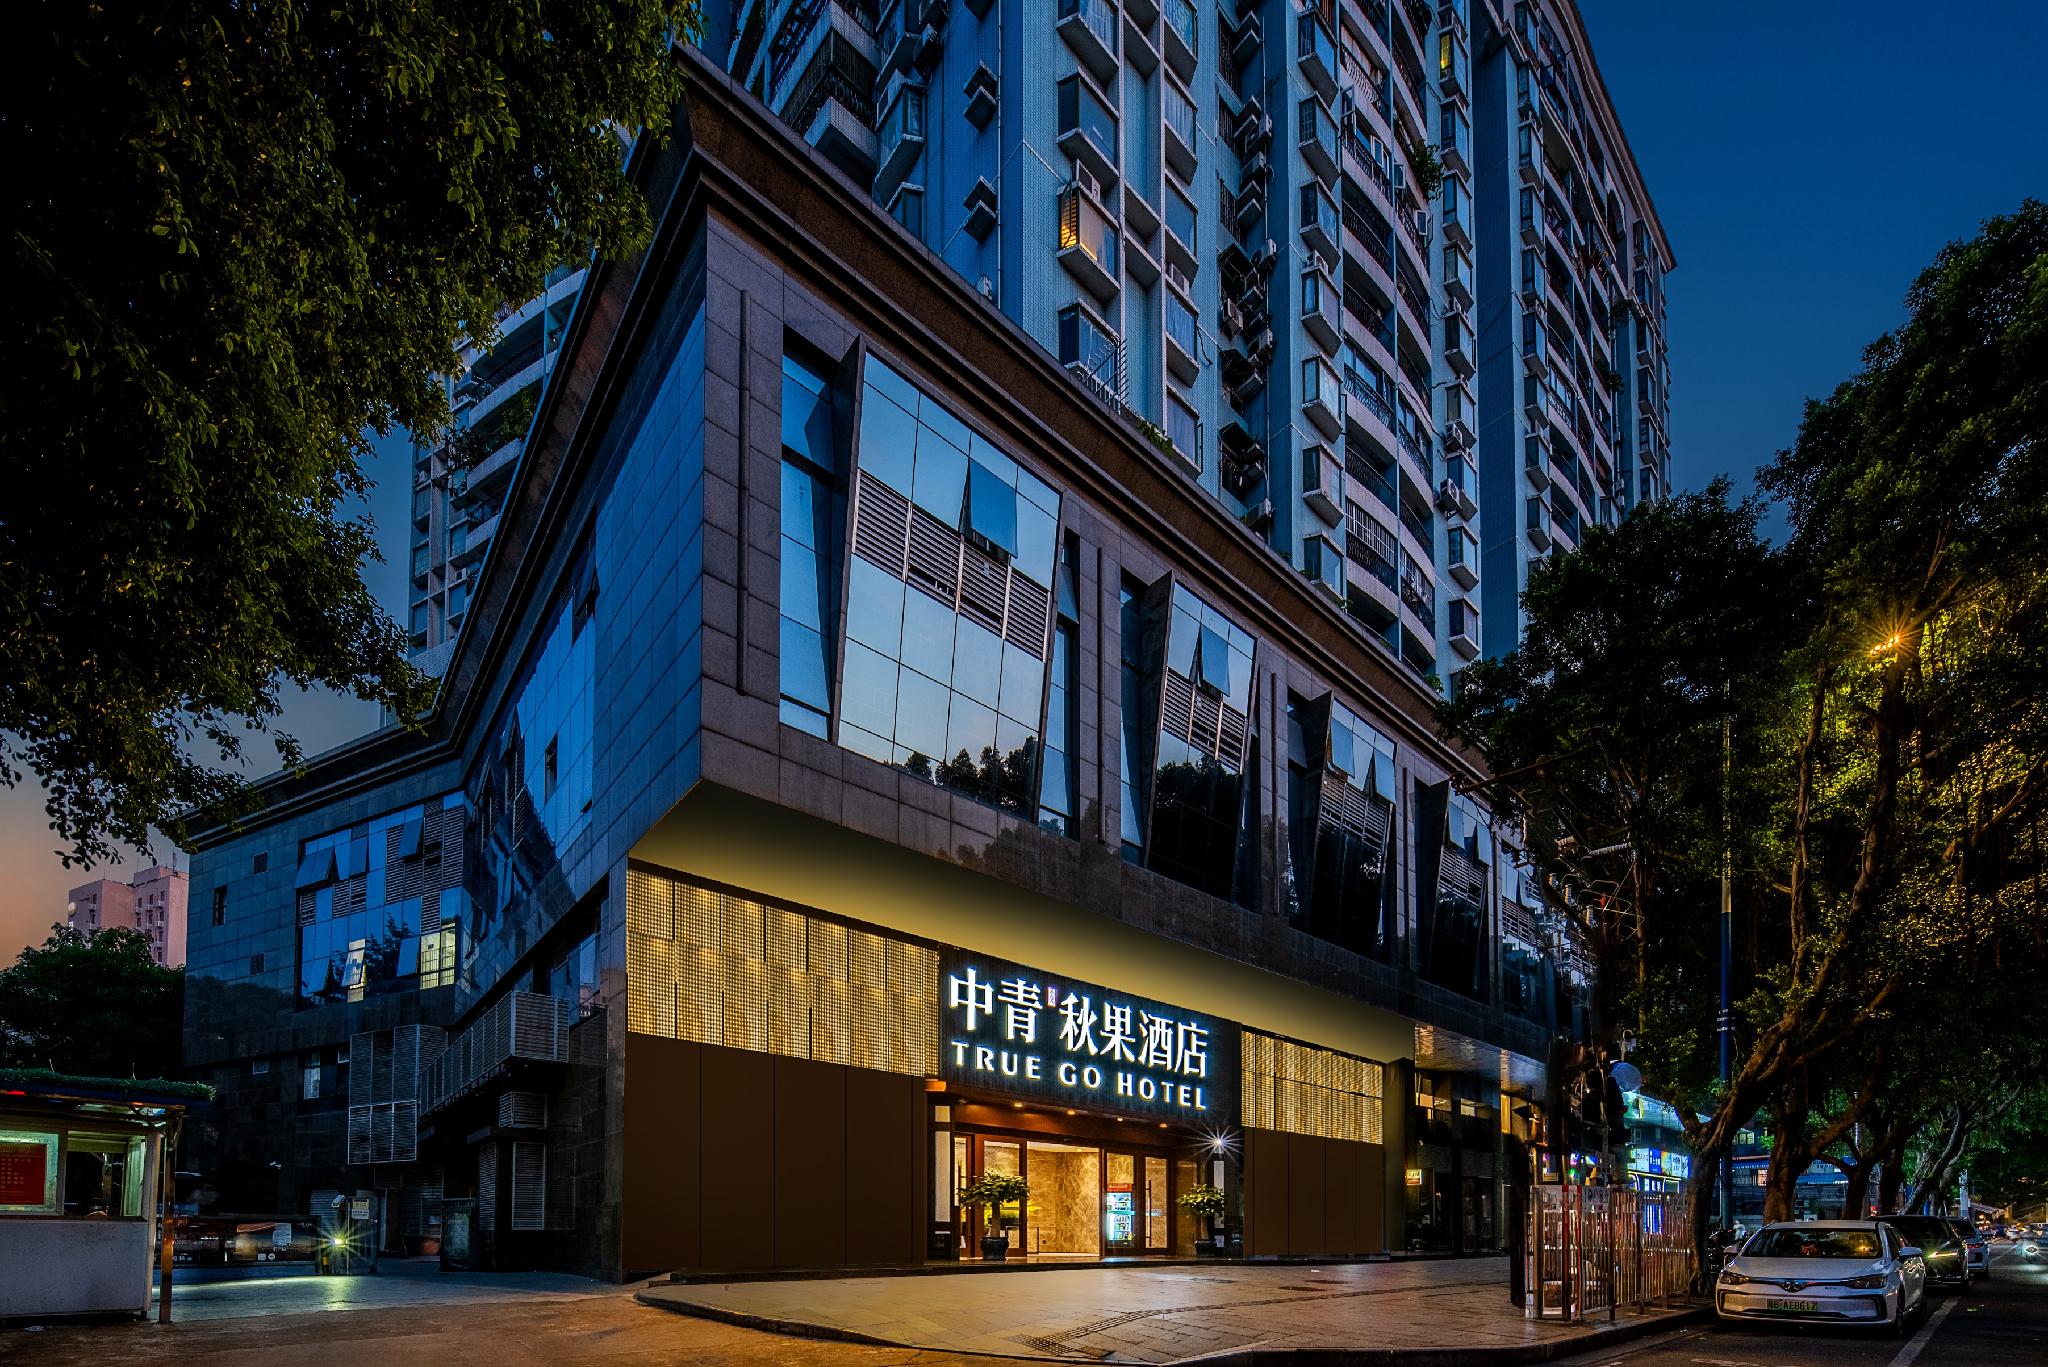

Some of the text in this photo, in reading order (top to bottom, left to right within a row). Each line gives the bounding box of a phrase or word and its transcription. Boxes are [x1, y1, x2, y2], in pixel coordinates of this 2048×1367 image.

[951, 1040, 1206, 1110] TRUE GO HOTEL
